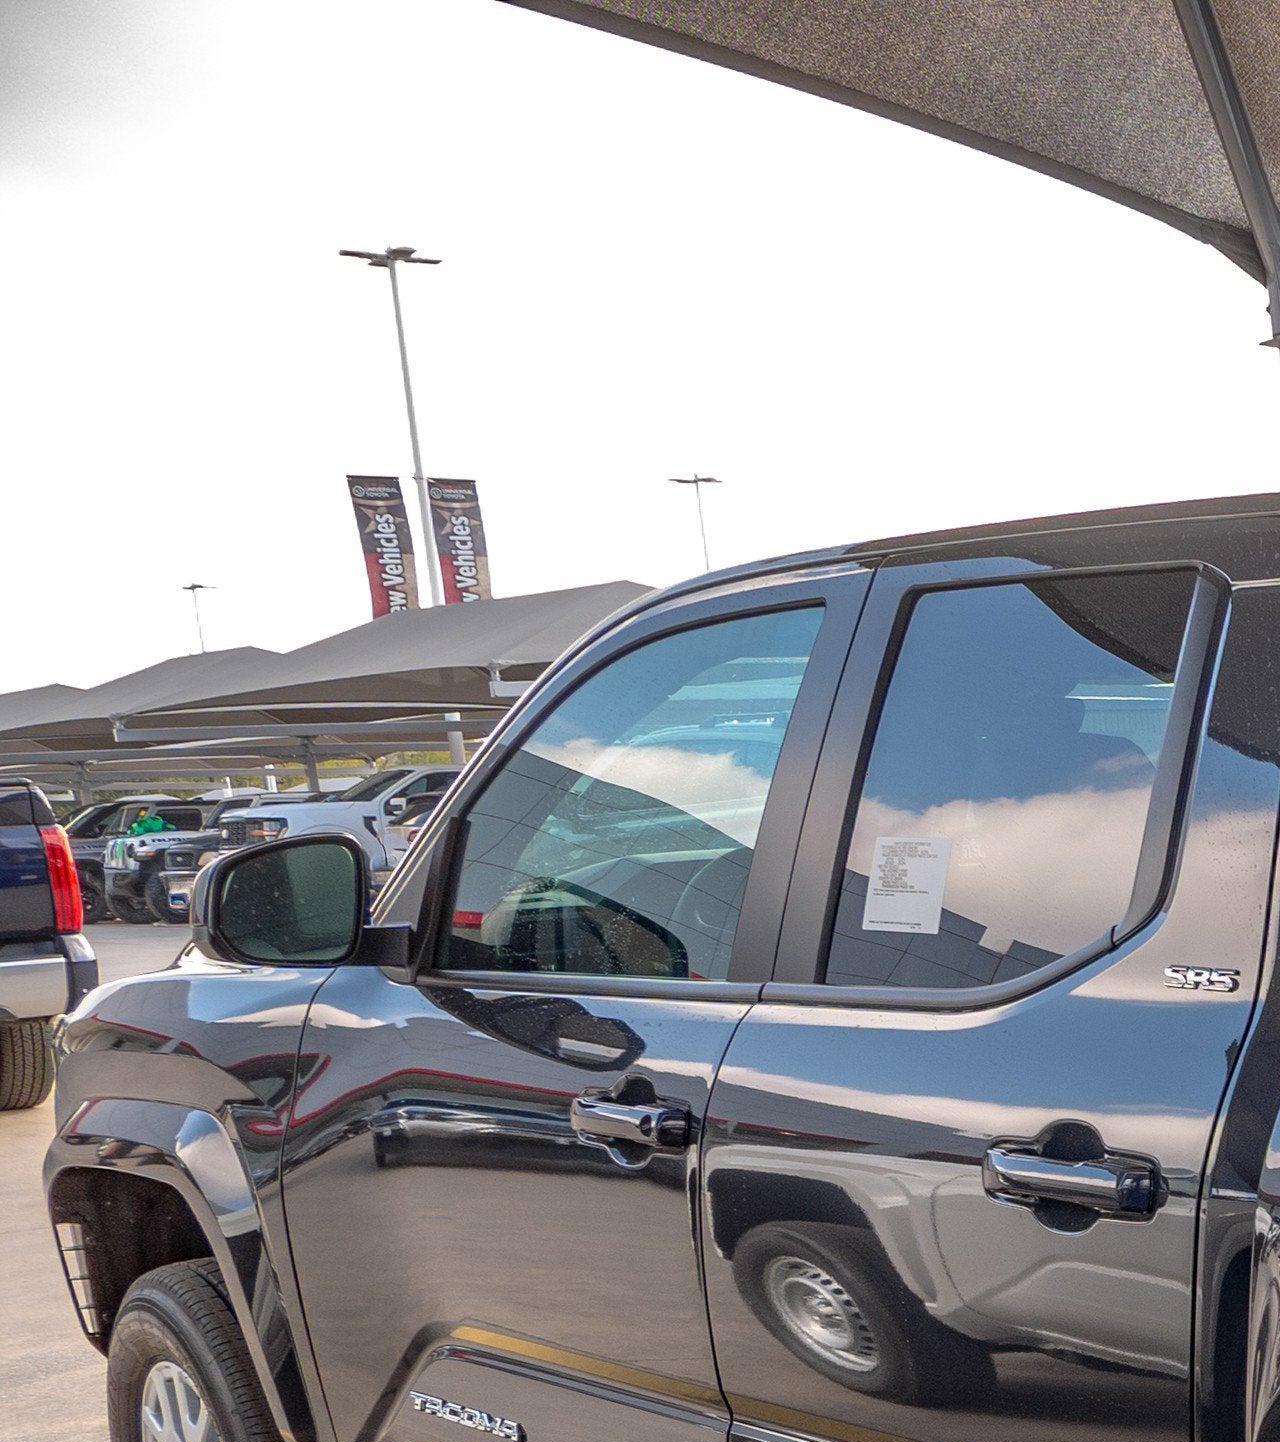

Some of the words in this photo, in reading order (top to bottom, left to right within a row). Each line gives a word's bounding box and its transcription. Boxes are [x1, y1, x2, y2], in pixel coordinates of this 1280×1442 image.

[373, 512, 407, 587] Vehicles
[449, 514, 479, 588] Vehicles
[1163, 964, 1242, 993] SR5
[409, 1390, 528, 1442] TACOMA
